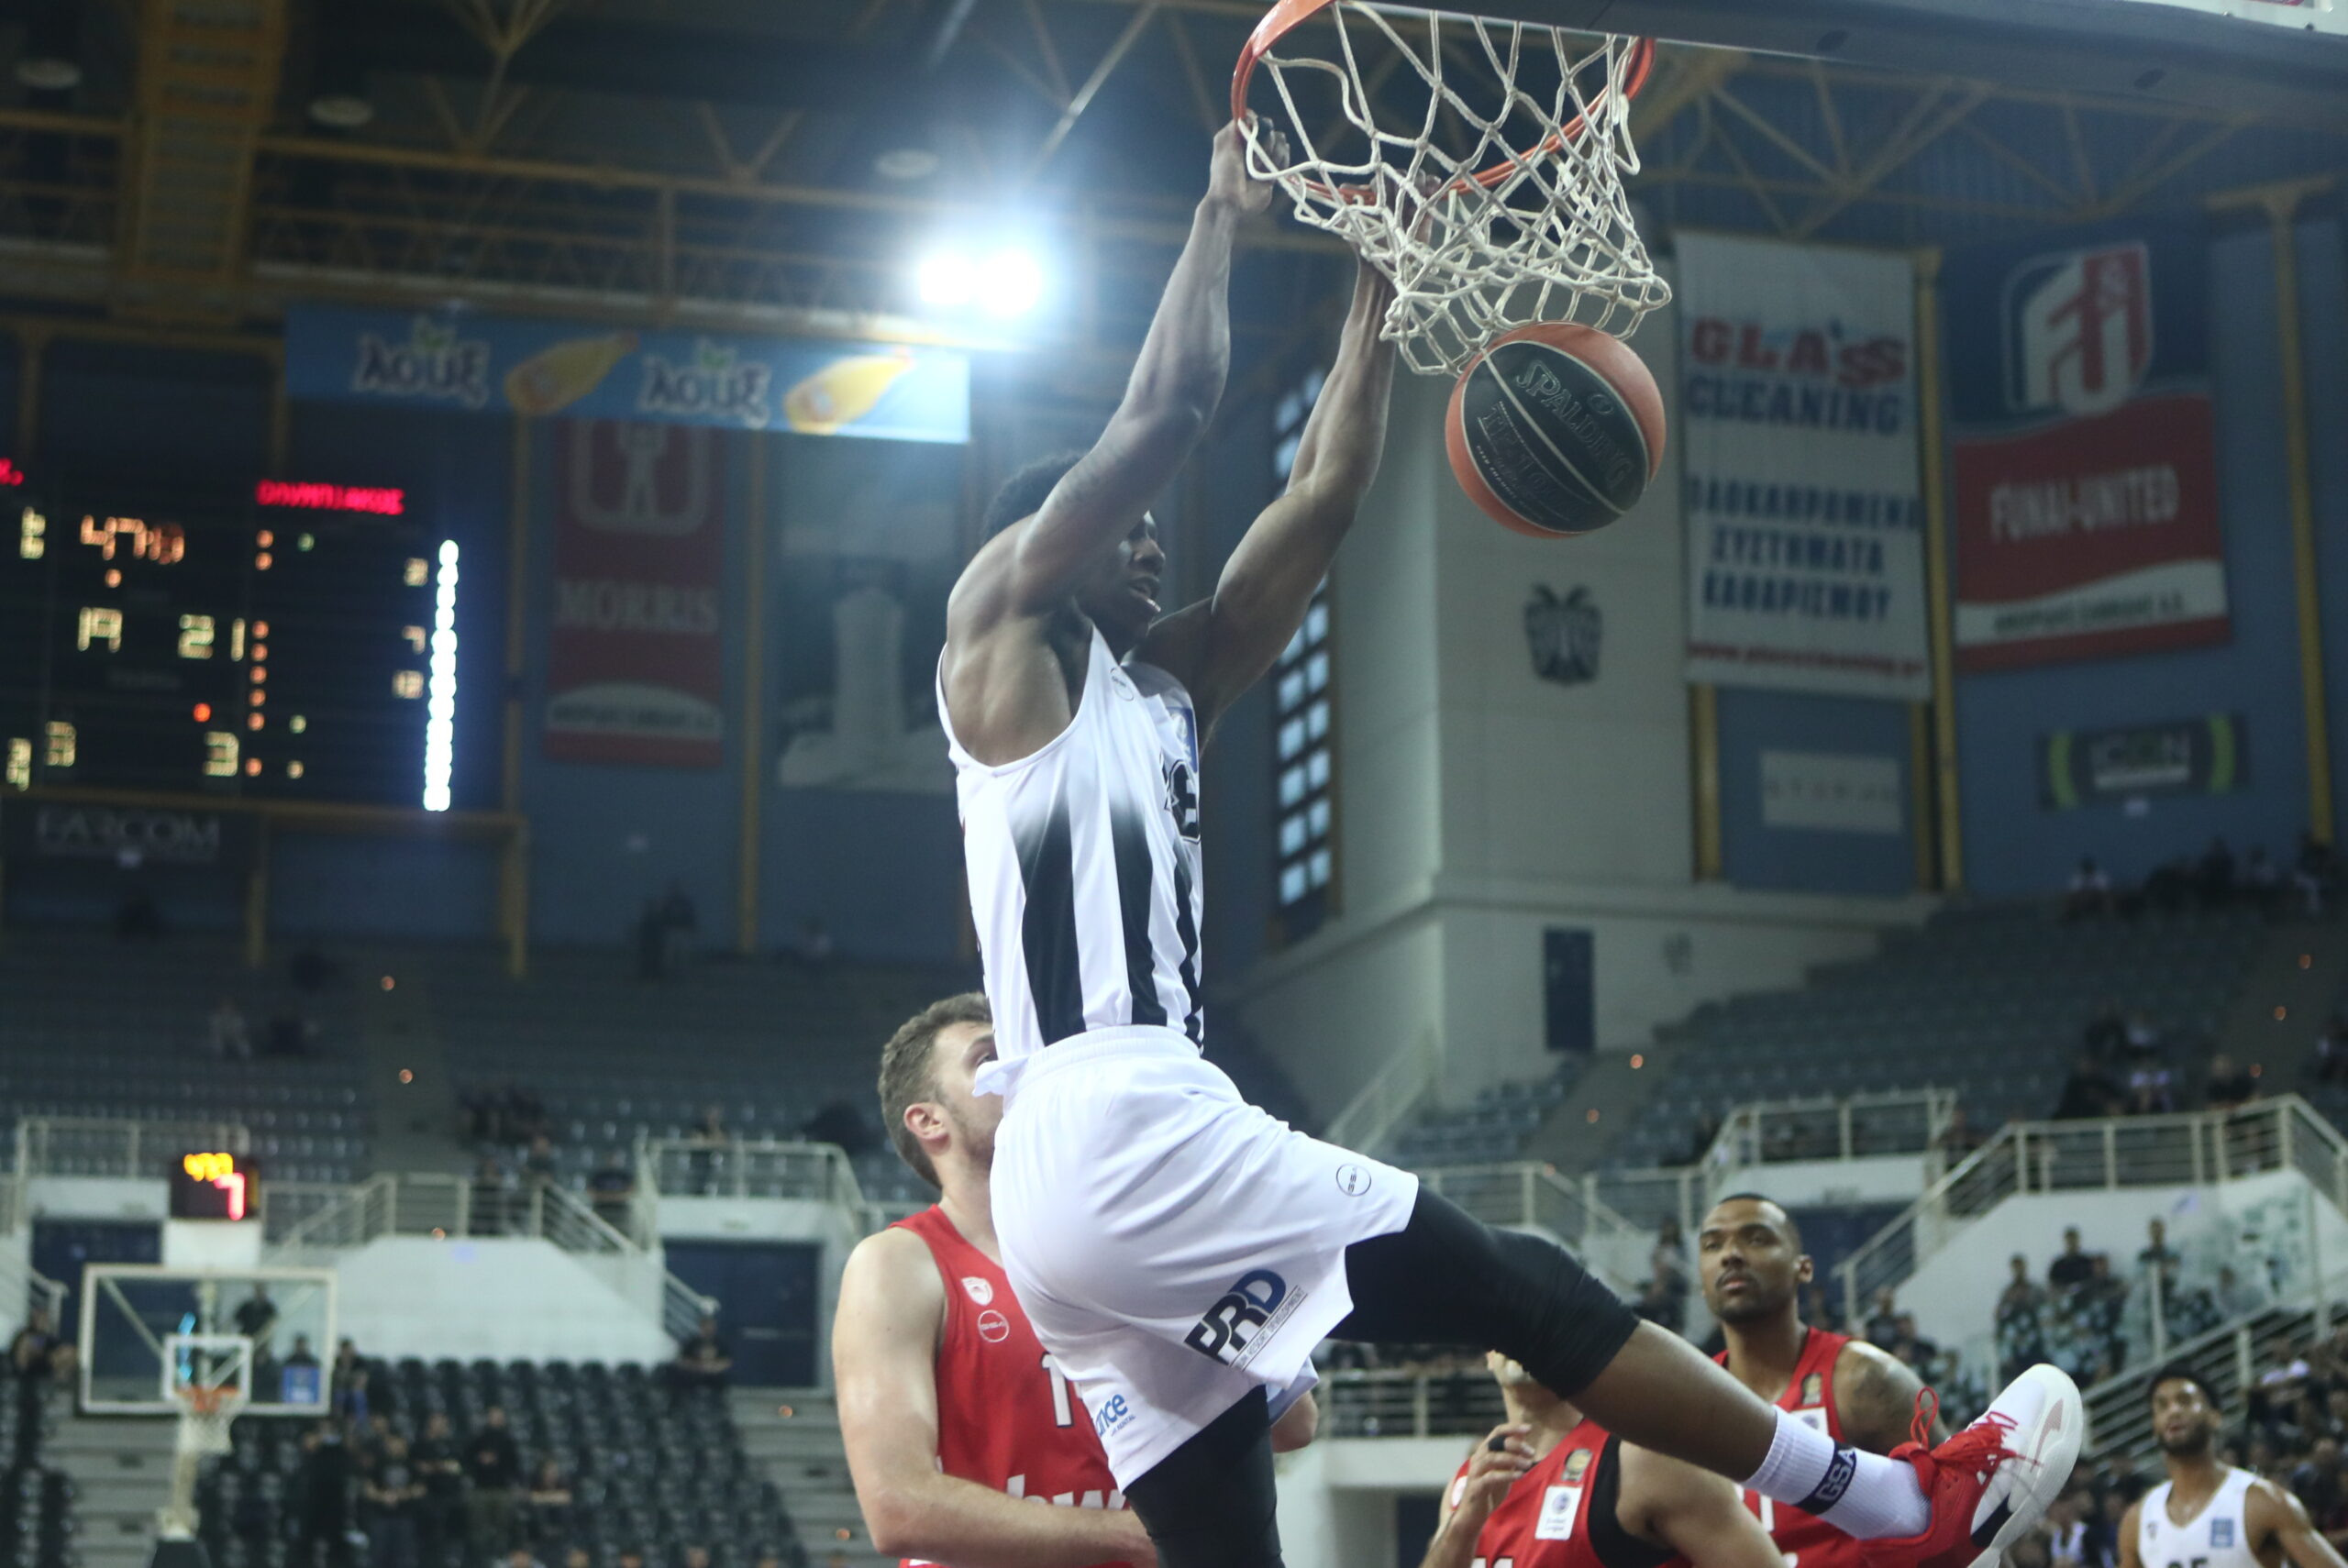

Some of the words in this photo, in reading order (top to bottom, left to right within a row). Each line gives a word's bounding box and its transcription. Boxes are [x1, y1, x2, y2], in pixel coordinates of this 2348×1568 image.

[1515, 359, 1634, 486] SPALDING
[1688, 374, 1901, 436] CLEANING
[554, 577, 719, 635] MORRIS
[1815, 1448, 1856, 1501] GSA
